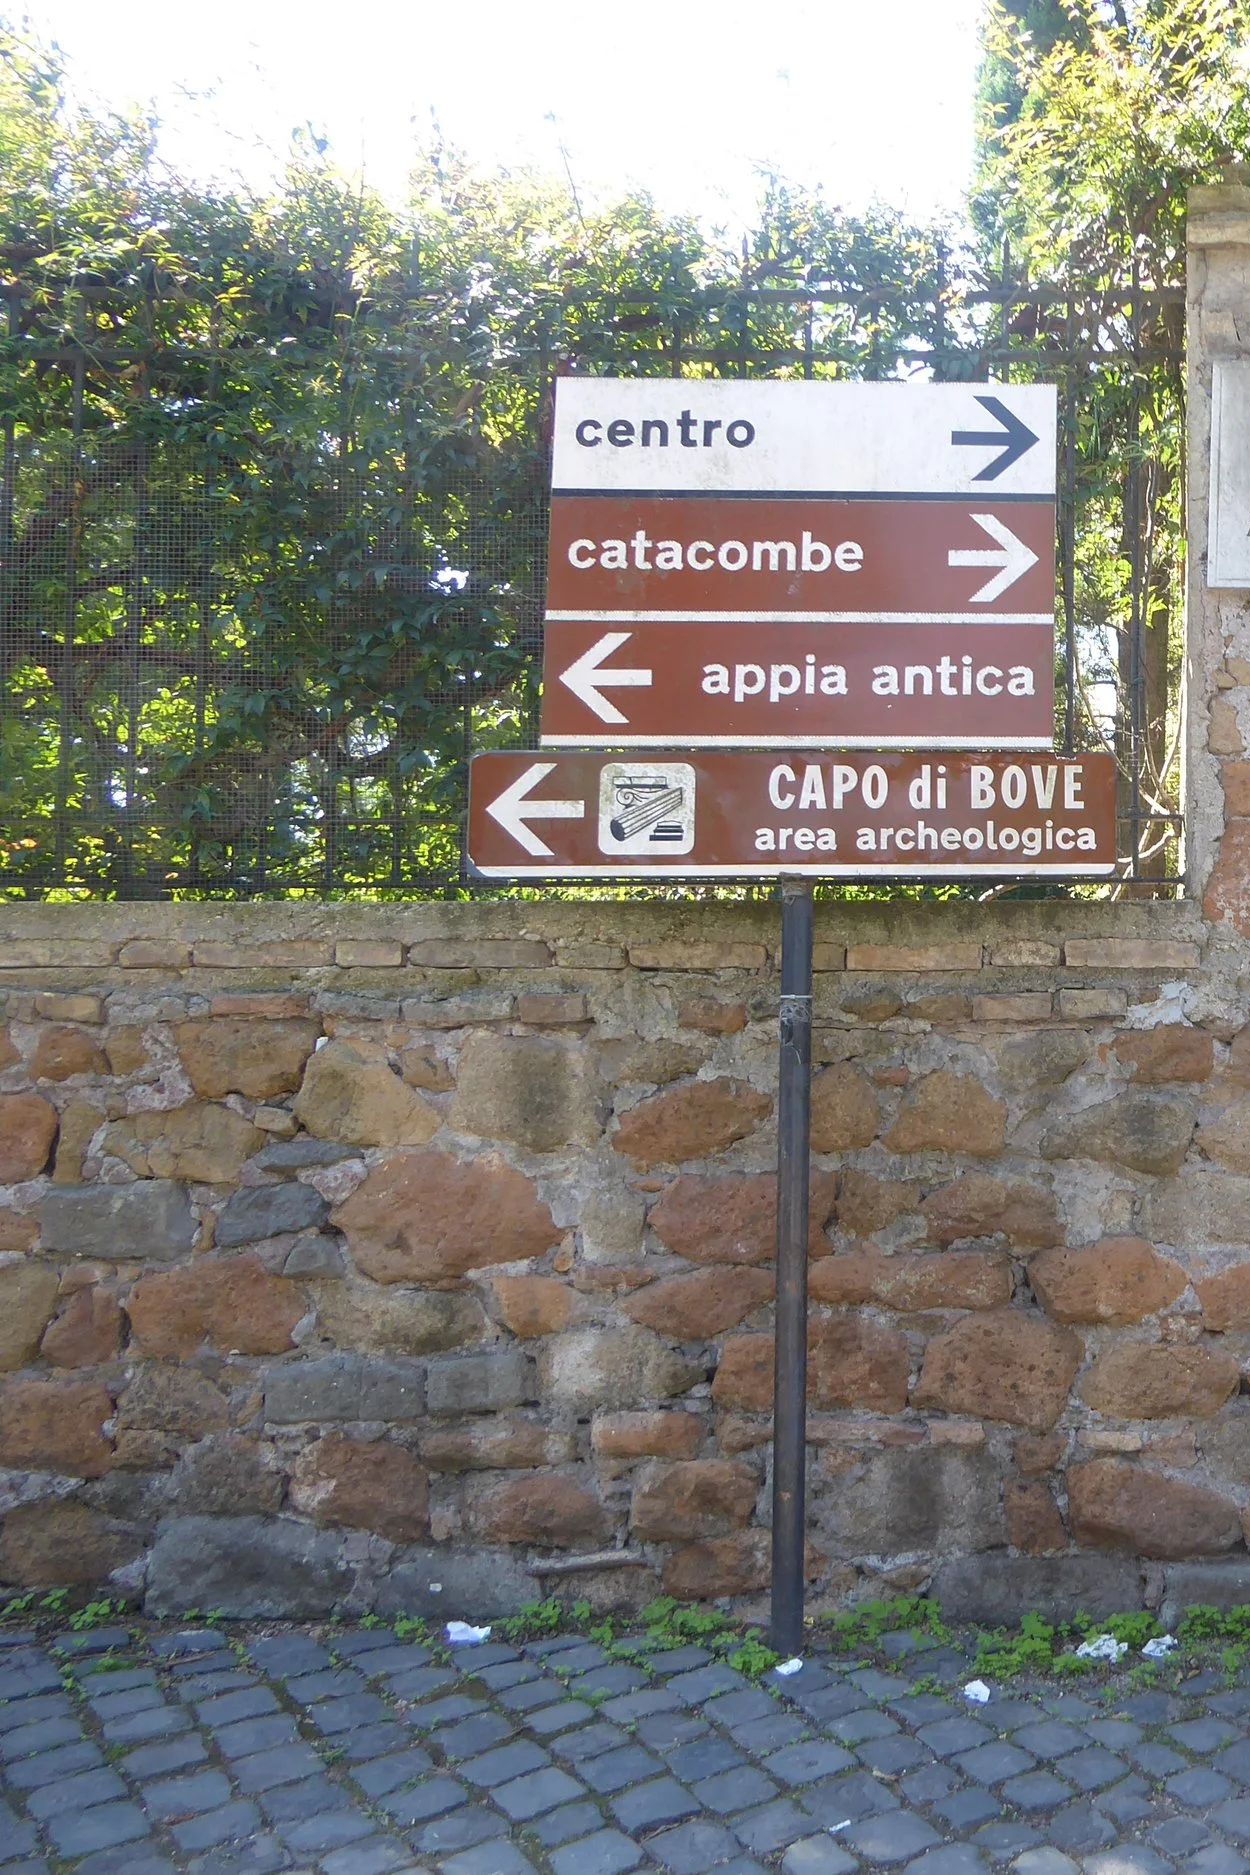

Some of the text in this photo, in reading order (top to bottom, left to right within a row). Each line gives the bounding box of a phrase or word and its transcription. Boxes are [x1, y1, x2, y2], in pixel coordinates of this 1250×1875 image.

[575, 409, 756, 448] centro
[568, 530, 864, 573] catacombe
[701, 654, 1036, 703] appia antica
[768, 764, 1086, 811] CAPO di BOVE
[754, 820, 1098, 857] area archeologica
